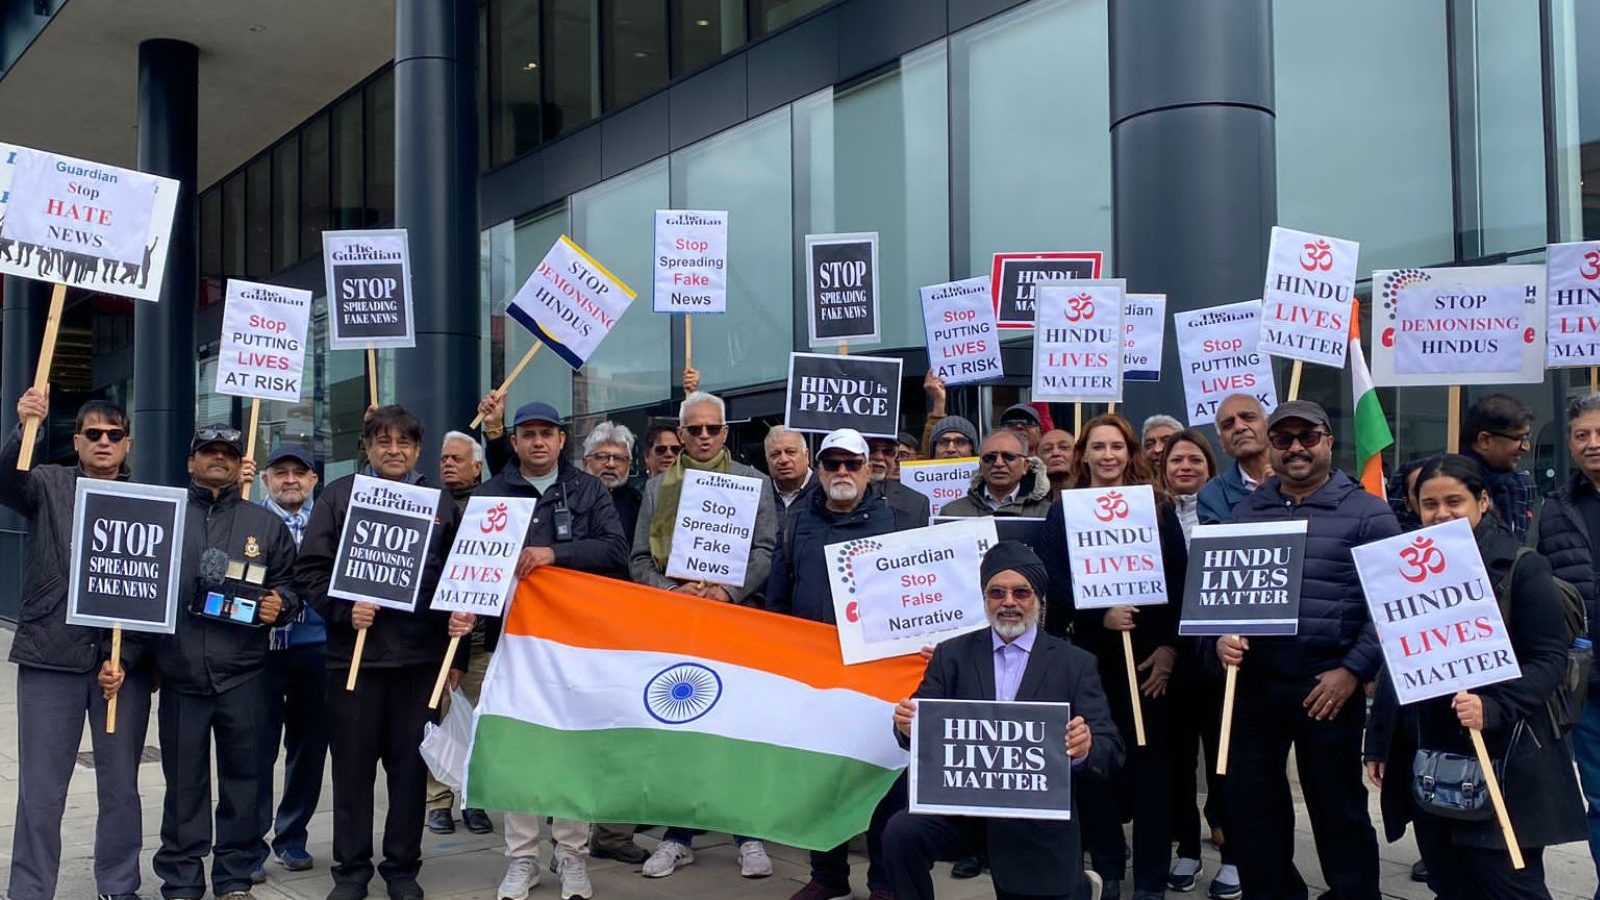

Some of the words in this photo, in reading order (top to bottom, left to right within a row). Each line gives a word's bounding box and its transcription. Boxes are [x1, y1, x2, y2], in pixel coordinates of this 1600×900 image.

[56, 161, 117, 183] Guardian
[67, 181, 99, 200] Stop
[46, 199, 113, 226] HATE
[48, 226, 103, 248] NEWS
[676, 239, 708, 252] Stop
[332, 250, 401, 261] Guardian
[345, 244, 373, 253] The
[660, 256, 723, 269] Spreading
[568, 261, 608, 295] STOP
[675, 273, 709, 285] Fake
[820, 260, 866, 288] STOP
[253, 288, 279, 297] The
[342, 278, 396, 299] STOP
[932, 286, 984, 300] Guardian
[1276, 274, 1348, 302] HINDU
[1558, 289, 1600, 305] HIN
[240, 291, 304, 306] Guardian
[344, 301, 397, 312] SPREADING
[671, 293, 711, 305] News
[820, 290, 866, 305] SPREADING
[1435, 295, 1487, 309] STOP
[344, 313, 369, 324] FAKE
[371, 313, 397, 324] NEWS
[536, 287, 592, 336] HINDUS
[821, 307, 843, 320] FAKE
[843, 305, 867, 319] NEWS
[944, 310, 975, 322] Stop
[1188, 312, 1254, 327] Guardian
[1200, 312, 1226, 320] The
[1275, 303, 1342, 330] LIVES
[250, 315, 286, 333] Stop
[934, 322, 990, 340] PUTTING
[1402, 317, 1519, 331] DEMONISING
[1562, 317, 1600, 333] LIV
[233, 333, 298, 350] PUTTING
[1047, 329, 1112, 343] HINDU
[1267, 330, 1343, 356] MATTER
[943, 340, 986, 357] LIVES
[1203, 339, 1242, 352] Stop
[1422, 339, 1498, 353] HINDUS
[1555, 343, 1600, 357] MAT
[238, 352, 289, 370] LIVES
[938, 364, 956, 377] AT
[962, 357, 998, 374] RISK
[1049, 353, 1108, 368] LIVES
[1192, 354, 1259, 374] PUTTING
[225, 372, 249, 386] AT
[255, 375, 296, 392] RISK
[801, 377, 874, 396] HINDU
[877, 383, 887, 394] is
[1043, 376, 1112, 388] MATTER
[1202, 374, 1255, 394] LIVES
[800, 393, 888, 416] PEACE
[1195, 401, 1218, 417] AT
[708, 475, 731, 483] The
[914, 469, 970, 482] Guardia
[372, 486, 402, 500] The
[696, 478, 754, 492] Guardian
[933, 488, 961, 498] Stop
[354, 491, 432, 515] Guardian
[702, 500, 736, 518] Stop
[353, 520, 419, 553] STOP
[682, 517, 749, 539] Spreading
[1077, 527, 1153, 547] HINDU
[92, 518, 164, 558] STOP
[693, 536, 730, 554] Fake
[350, 546, 414, 568] DEMONISING
[456, 540, 515, 557] HINDU
[1204, 547, 1292, 568] HINDU
[89, 556, 158, 579] SPREADING
[687, 557, 729, 575] News
[876, 548, 954, 571] Guardian
[1084, 555, 1154, 574] LIVES
[344, 560, 411, 587] HINDUS
[449, 565, 503, 582] LIVES
[901, 574, 936, 587] Stop
[1201, 568, 1288, 590] LIVES
[88, 577, 120, 596] FAKE
[122, 581, 157, 599] NEWS
[1083, 581, 1164, 598] MATTER
[438, 589, 499, 607] MATTER
[902, 592, 943, 607] False
[1200, 590, 1288, 606] MATTER
[1383, 579, 1484, 623] HINDU
[889, 609, 963, 631] Narrative
[1400, 616, 1493, 657] LIVES
[1403, 650, 1513, 689] MATTER
[943, 718, 1047, 743] HINDU
[943, 744, 1045, 771] LIVES
[943, 771, 1048, 791] MATTER
